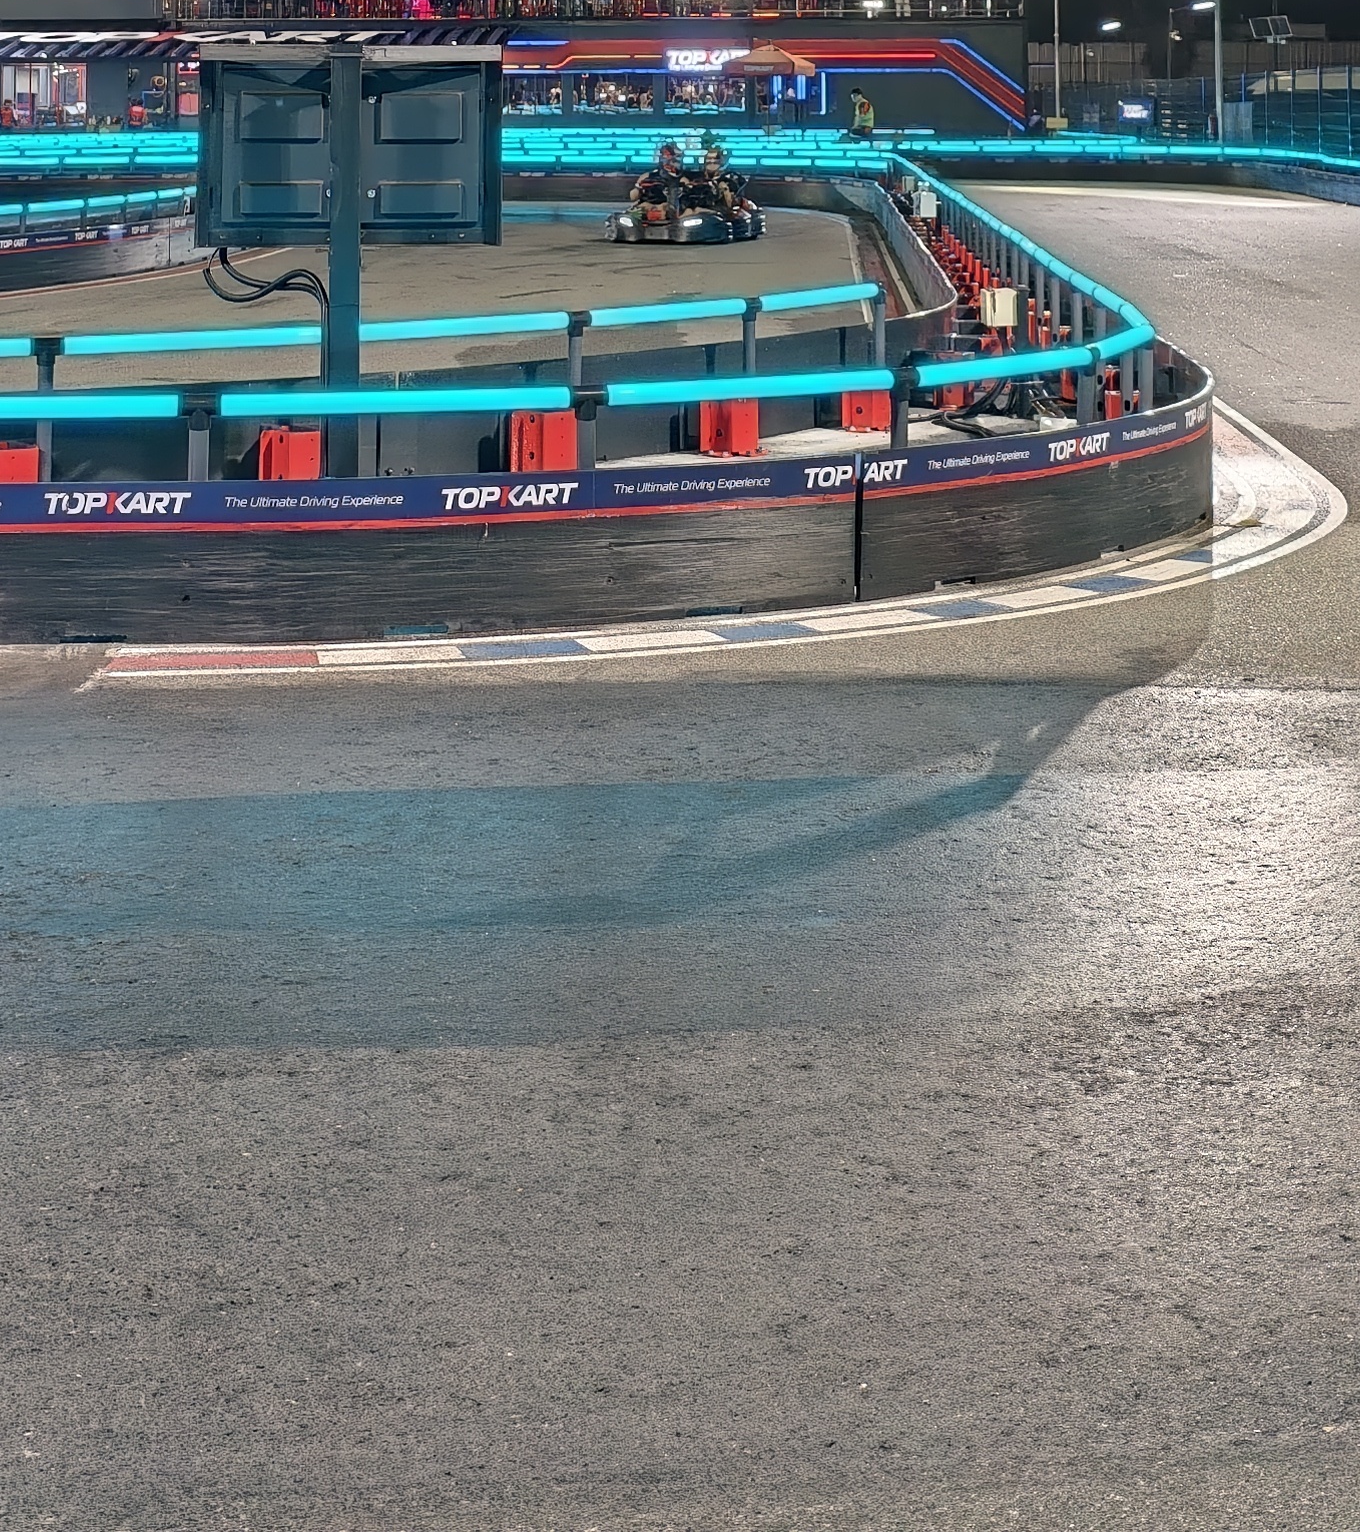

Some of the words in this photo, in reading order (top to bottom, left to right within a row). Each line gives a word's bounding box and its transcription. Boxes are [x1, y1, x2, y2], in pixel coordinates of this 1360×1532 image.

[928, 459, 942, 470] The
[942, 456, 971, 469] Ultimate
[971, 453, 995, 467] Driving
[995, 449, 1030, 464] Experience
[614, 482, 634, 495] The
[636, 480, 679, 494] Ultimate
[680, 478, 715, 492] Driving
[717, 475, 771, 490] Experience
[44, 491, 192, 515] TOPKART
[224, 496, 247, 508] The
[249, 495, 297, 508] Ultimate
[300, 495, 339, 509] Driving
[341, 494, 404, 508] Experience
[440, 482, 579, 510] TOPKART
